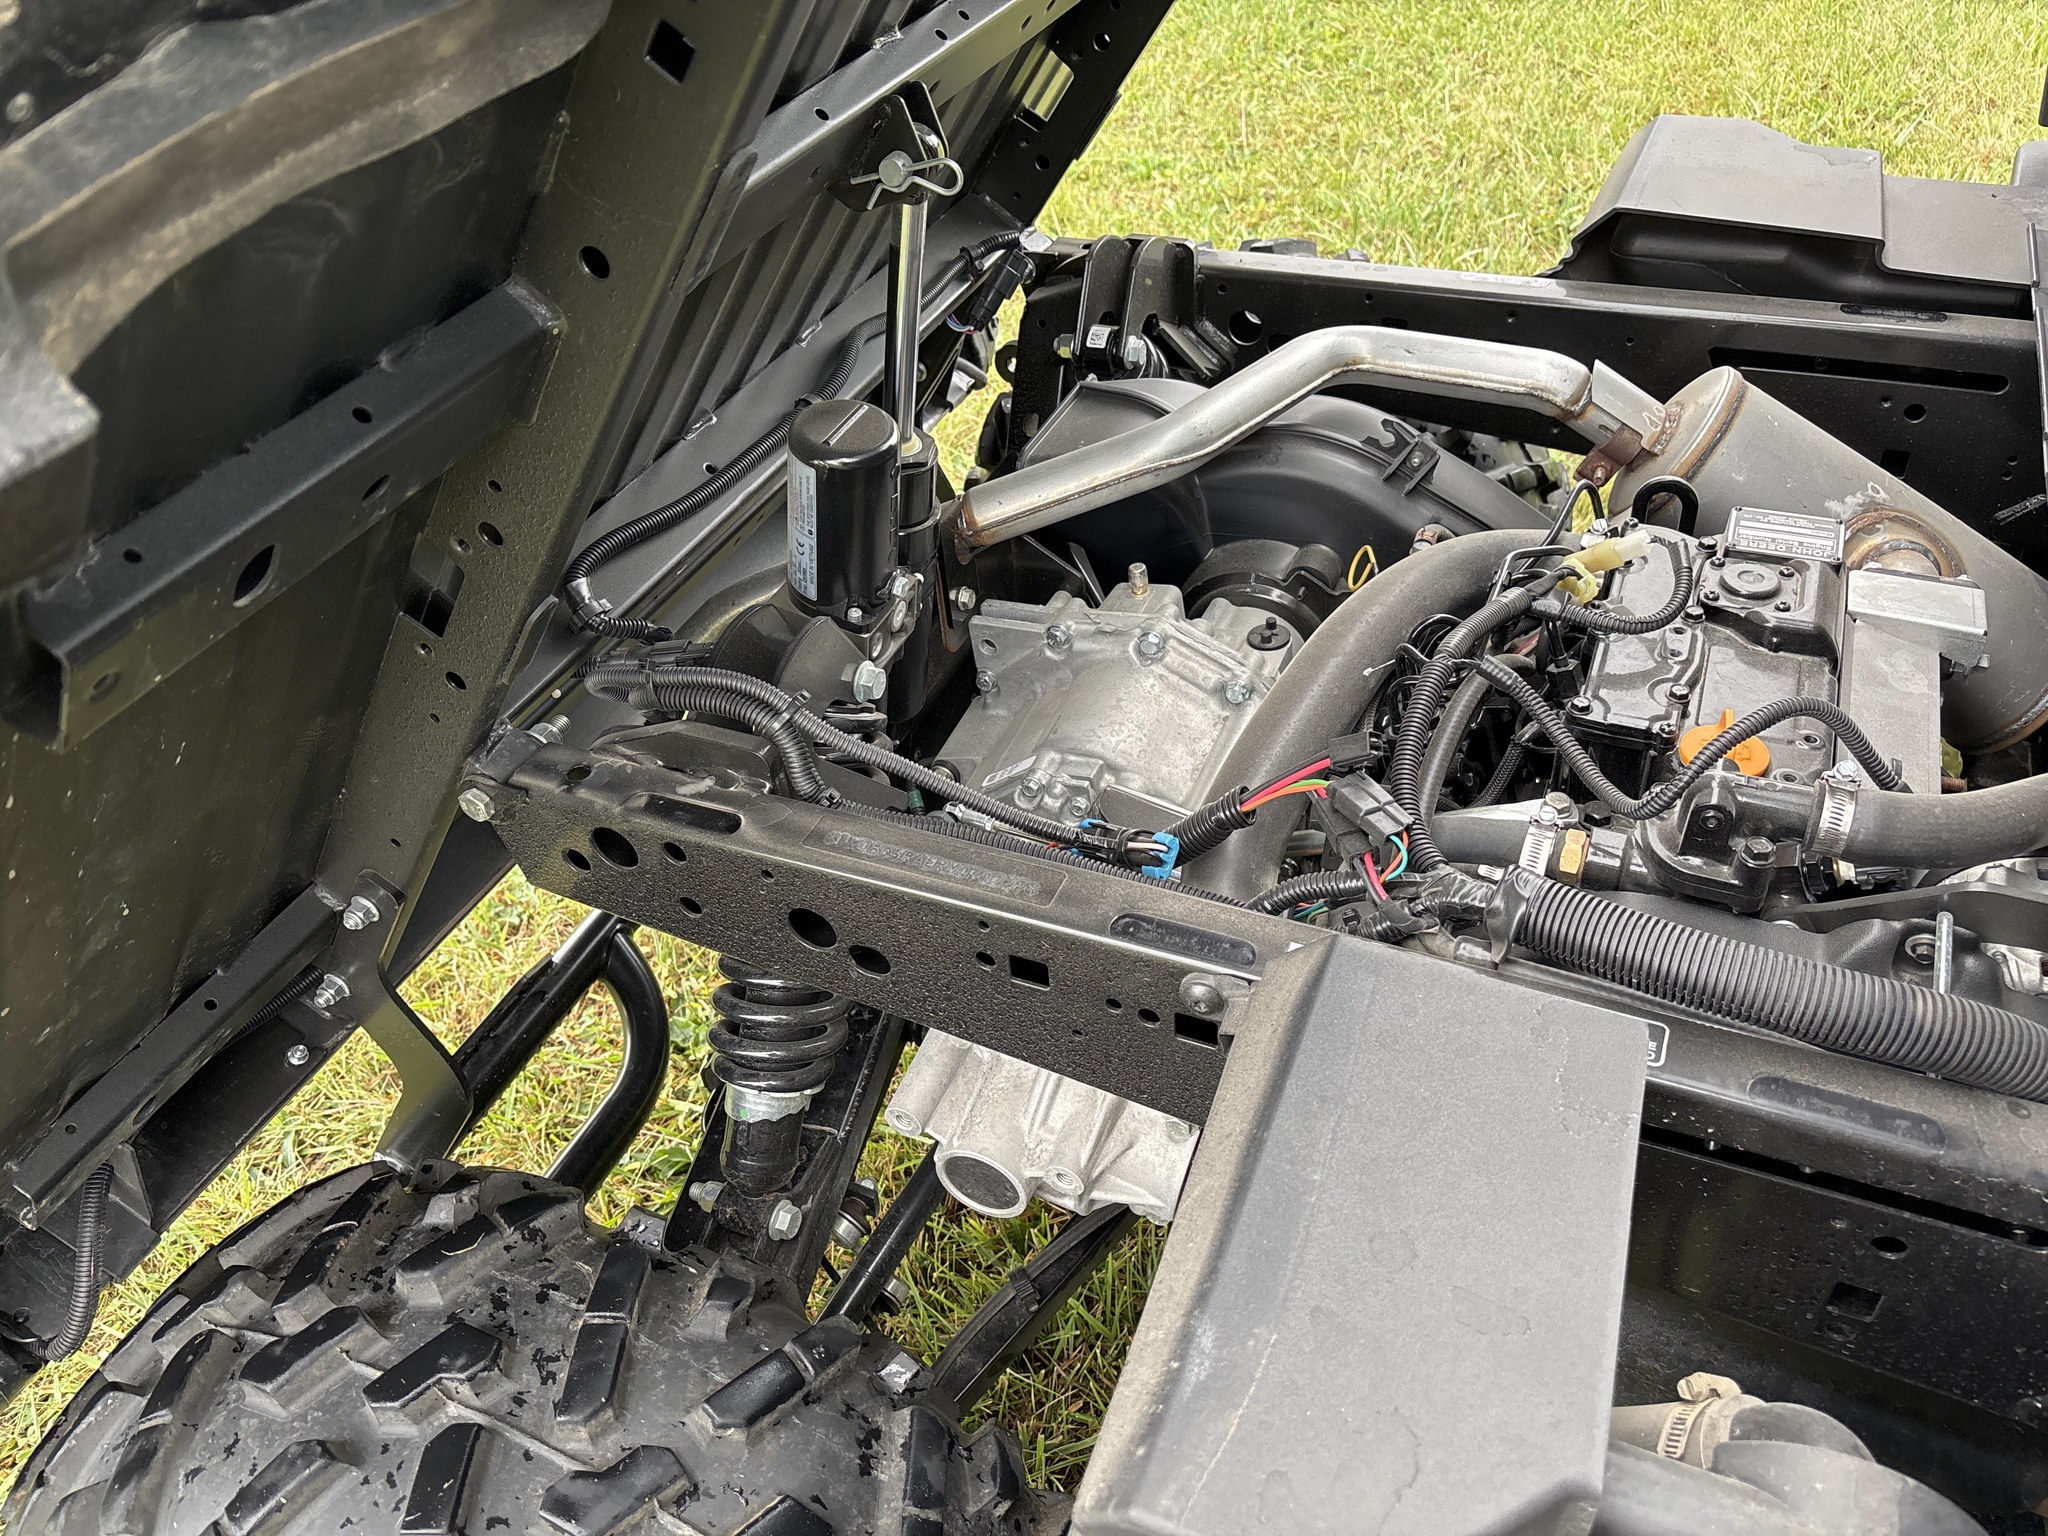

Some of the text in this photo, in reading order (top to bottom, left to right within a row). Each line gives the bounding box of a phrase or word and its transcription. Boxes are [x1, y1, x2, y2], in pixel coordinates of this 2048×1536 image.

[1737, 533, 1831, 550] Engine Serial Number
[1738, 538, 1831, 558] JOHN DEERE
